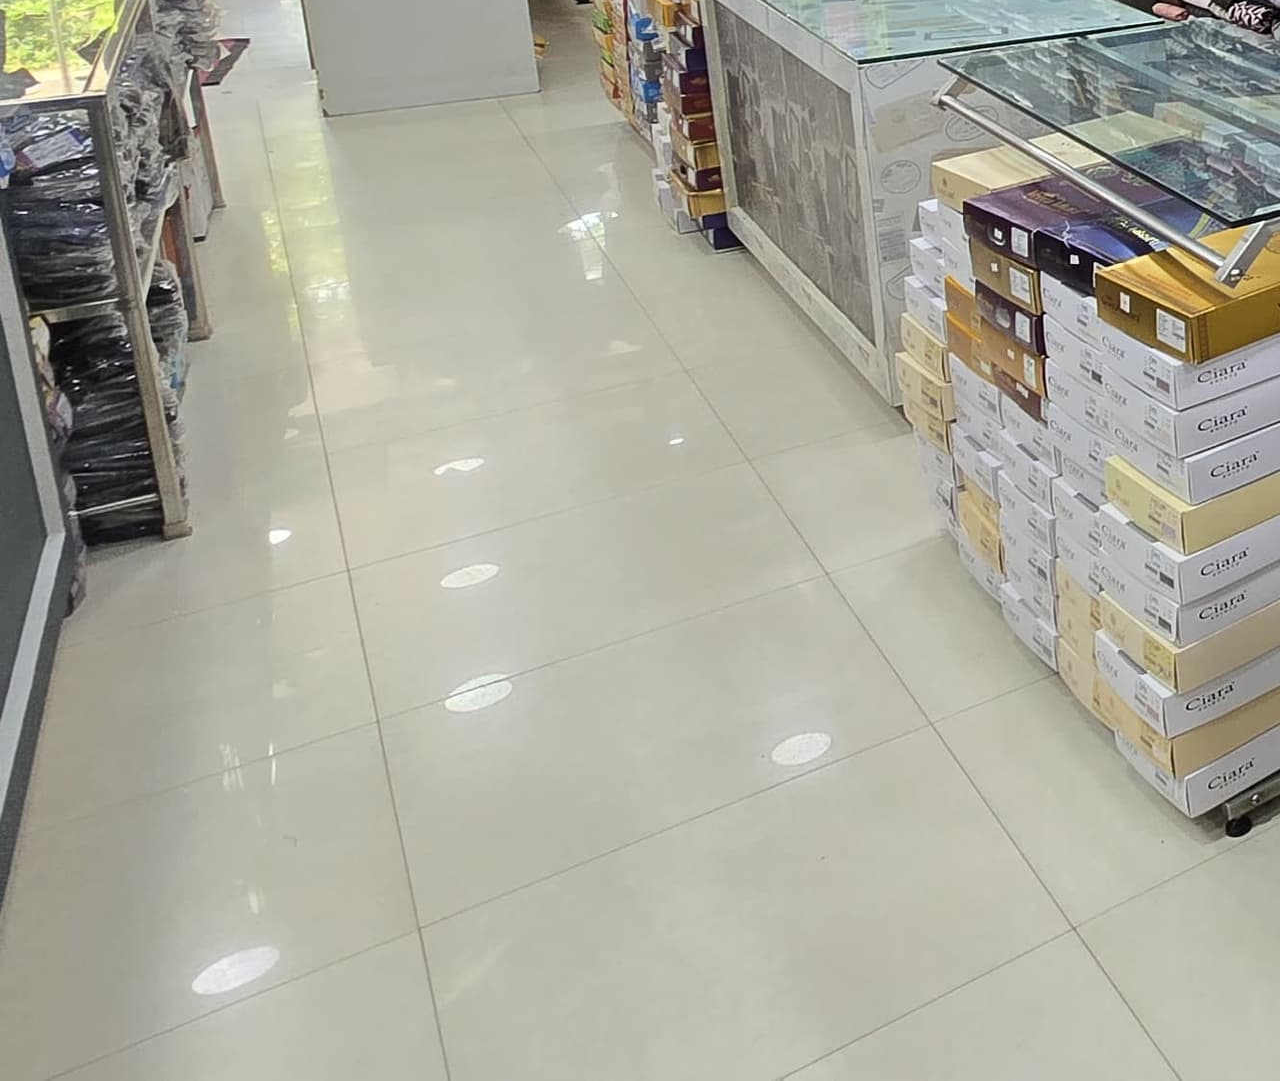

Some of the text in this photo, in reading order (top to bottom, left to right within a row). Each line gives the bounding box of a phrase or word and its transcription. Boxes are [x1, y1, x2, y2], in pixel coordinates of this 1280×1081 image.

[1197, 359, 1248, 385] Ciara
[1197, 406, 1248, 432] Ciara
[1210, 451, 1260, 478] Ciara
[1200, 547, 1249, 576] Ciara
[1199, 590, 1248, 620] Ciara
[1185, 681, 1236, 712] Ciara
[1207, 757, 1255, 790] Ciara
